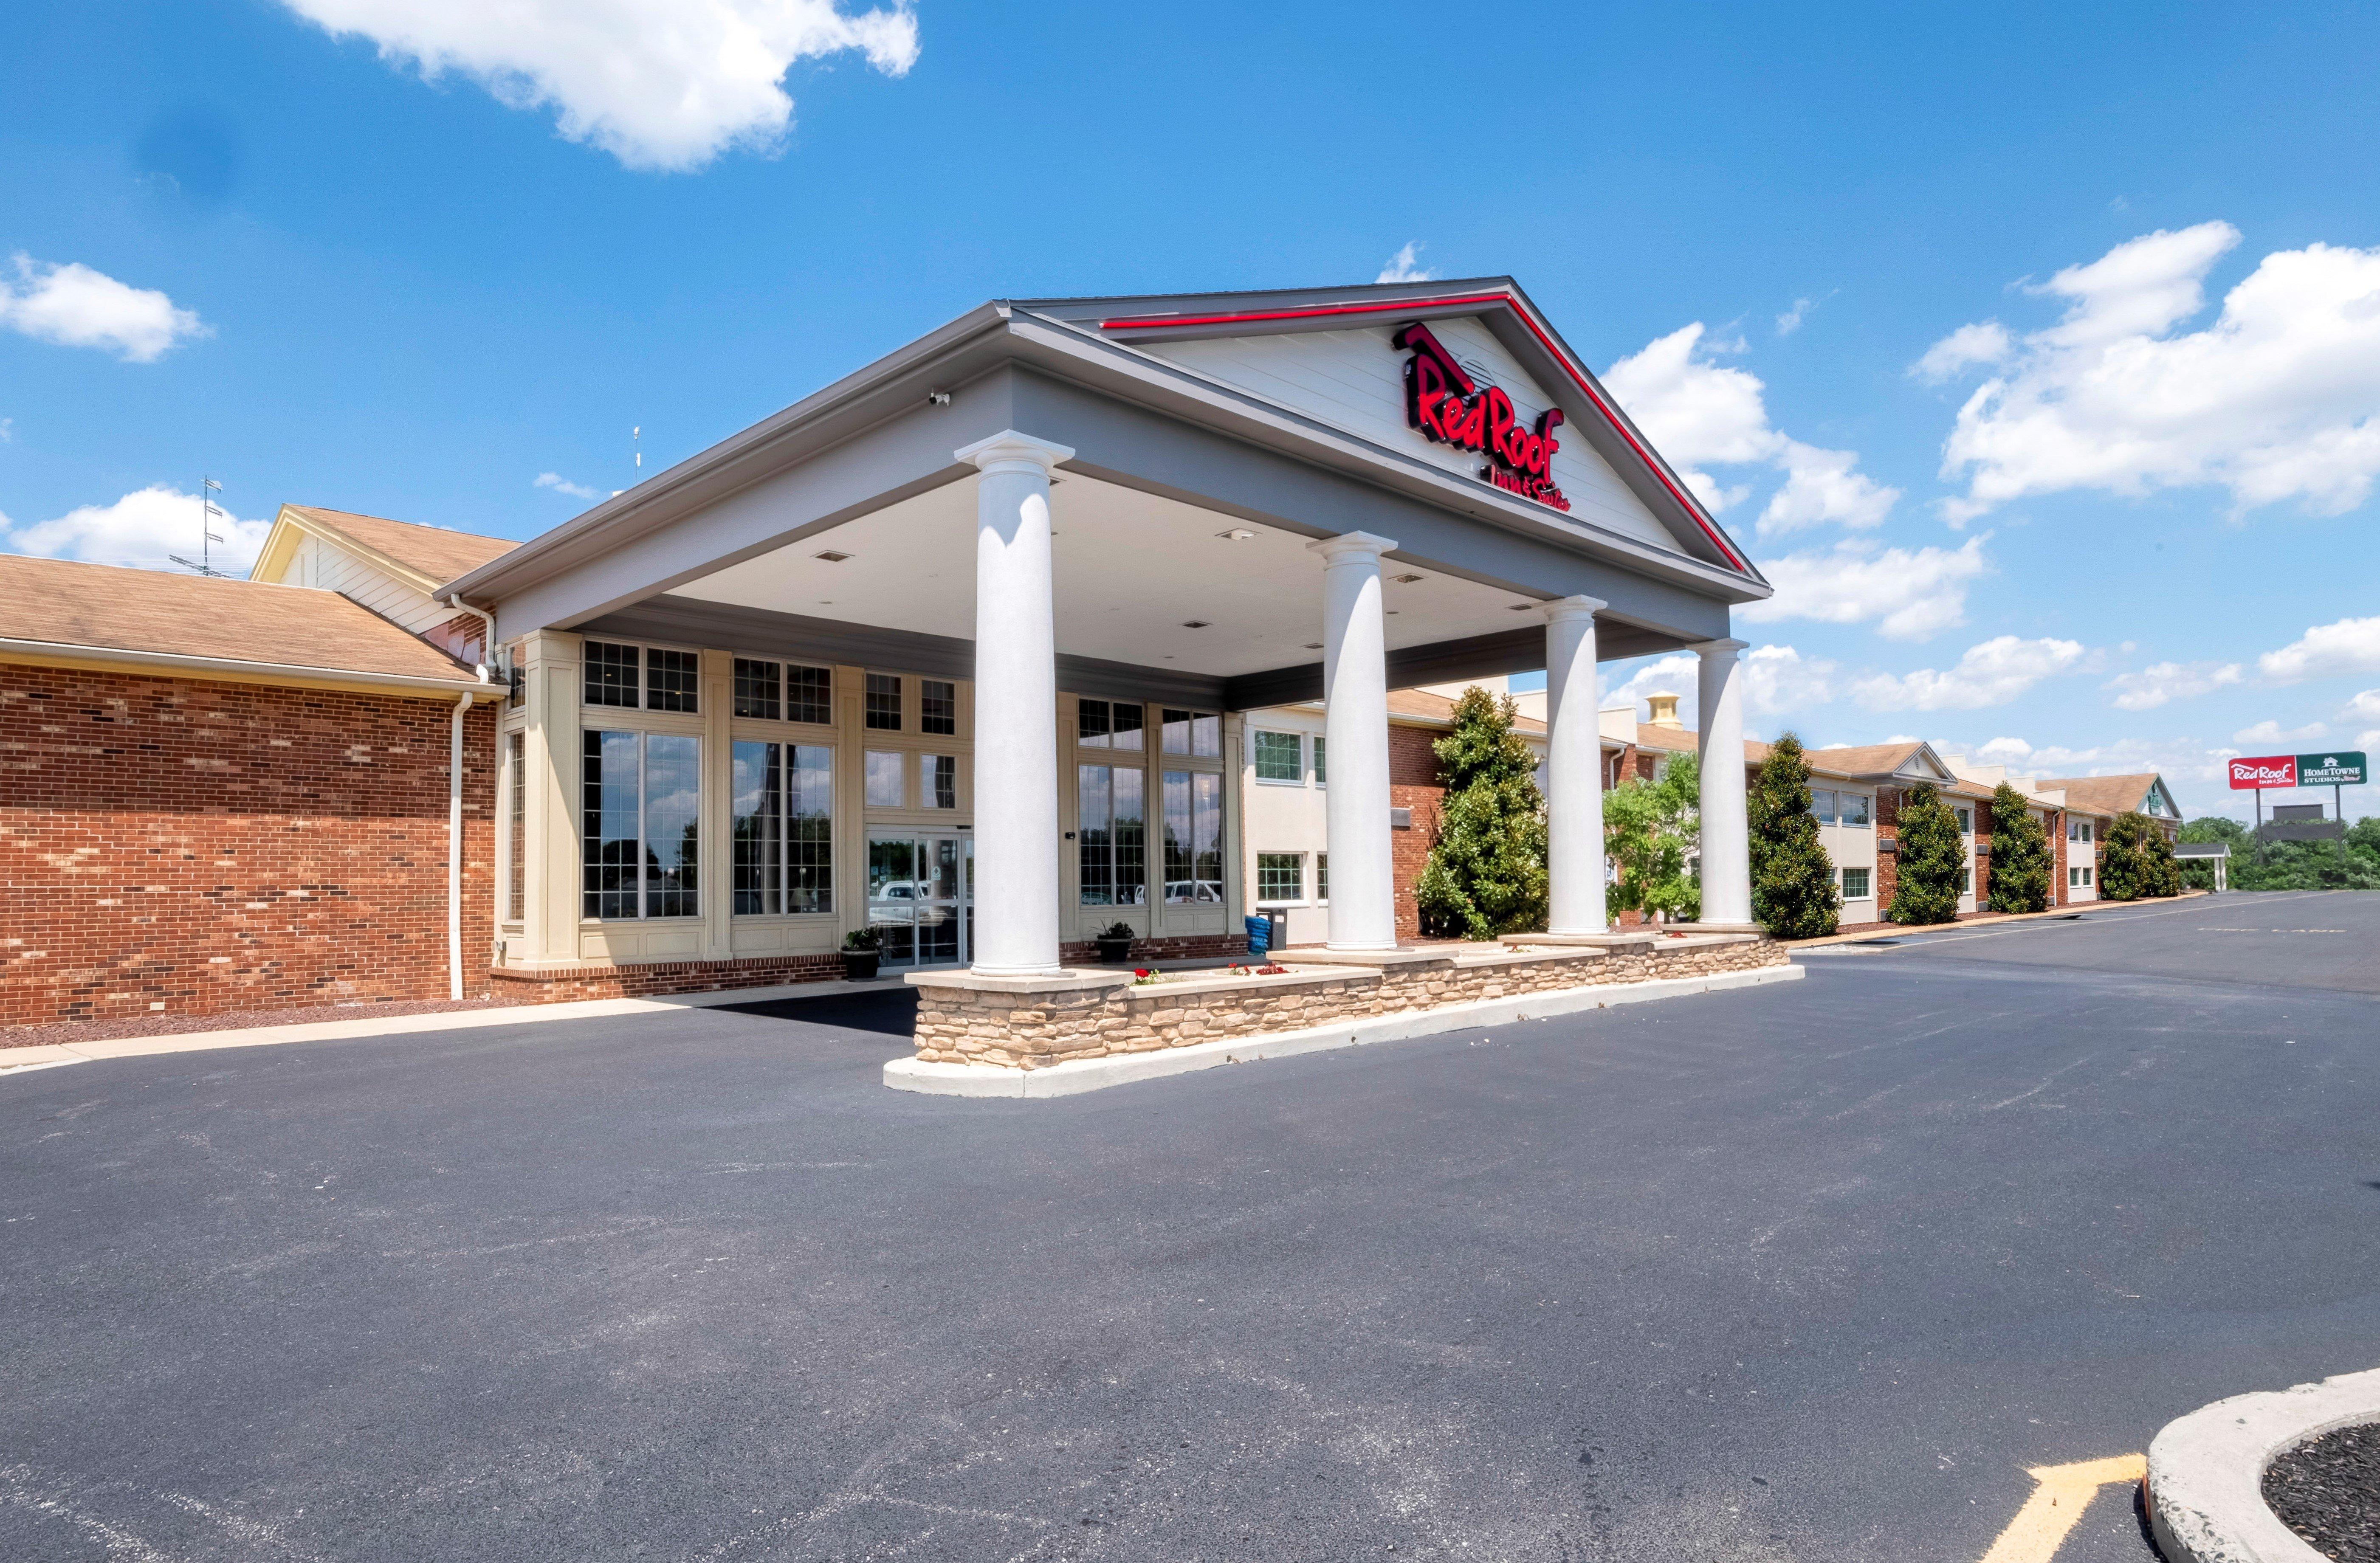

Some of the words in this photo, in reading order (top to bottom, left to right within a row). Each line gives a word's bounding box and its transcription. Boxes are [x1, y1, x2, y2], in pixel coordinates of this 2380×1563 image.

[1404, 353, 1486, 448] Red
[1488, 385, 1565, 485] Roof
[1490, 464, 1522, 497] Inn
[2233, 767, 2259, 780] Red
[2259, 763, 2292, 779] Roof
